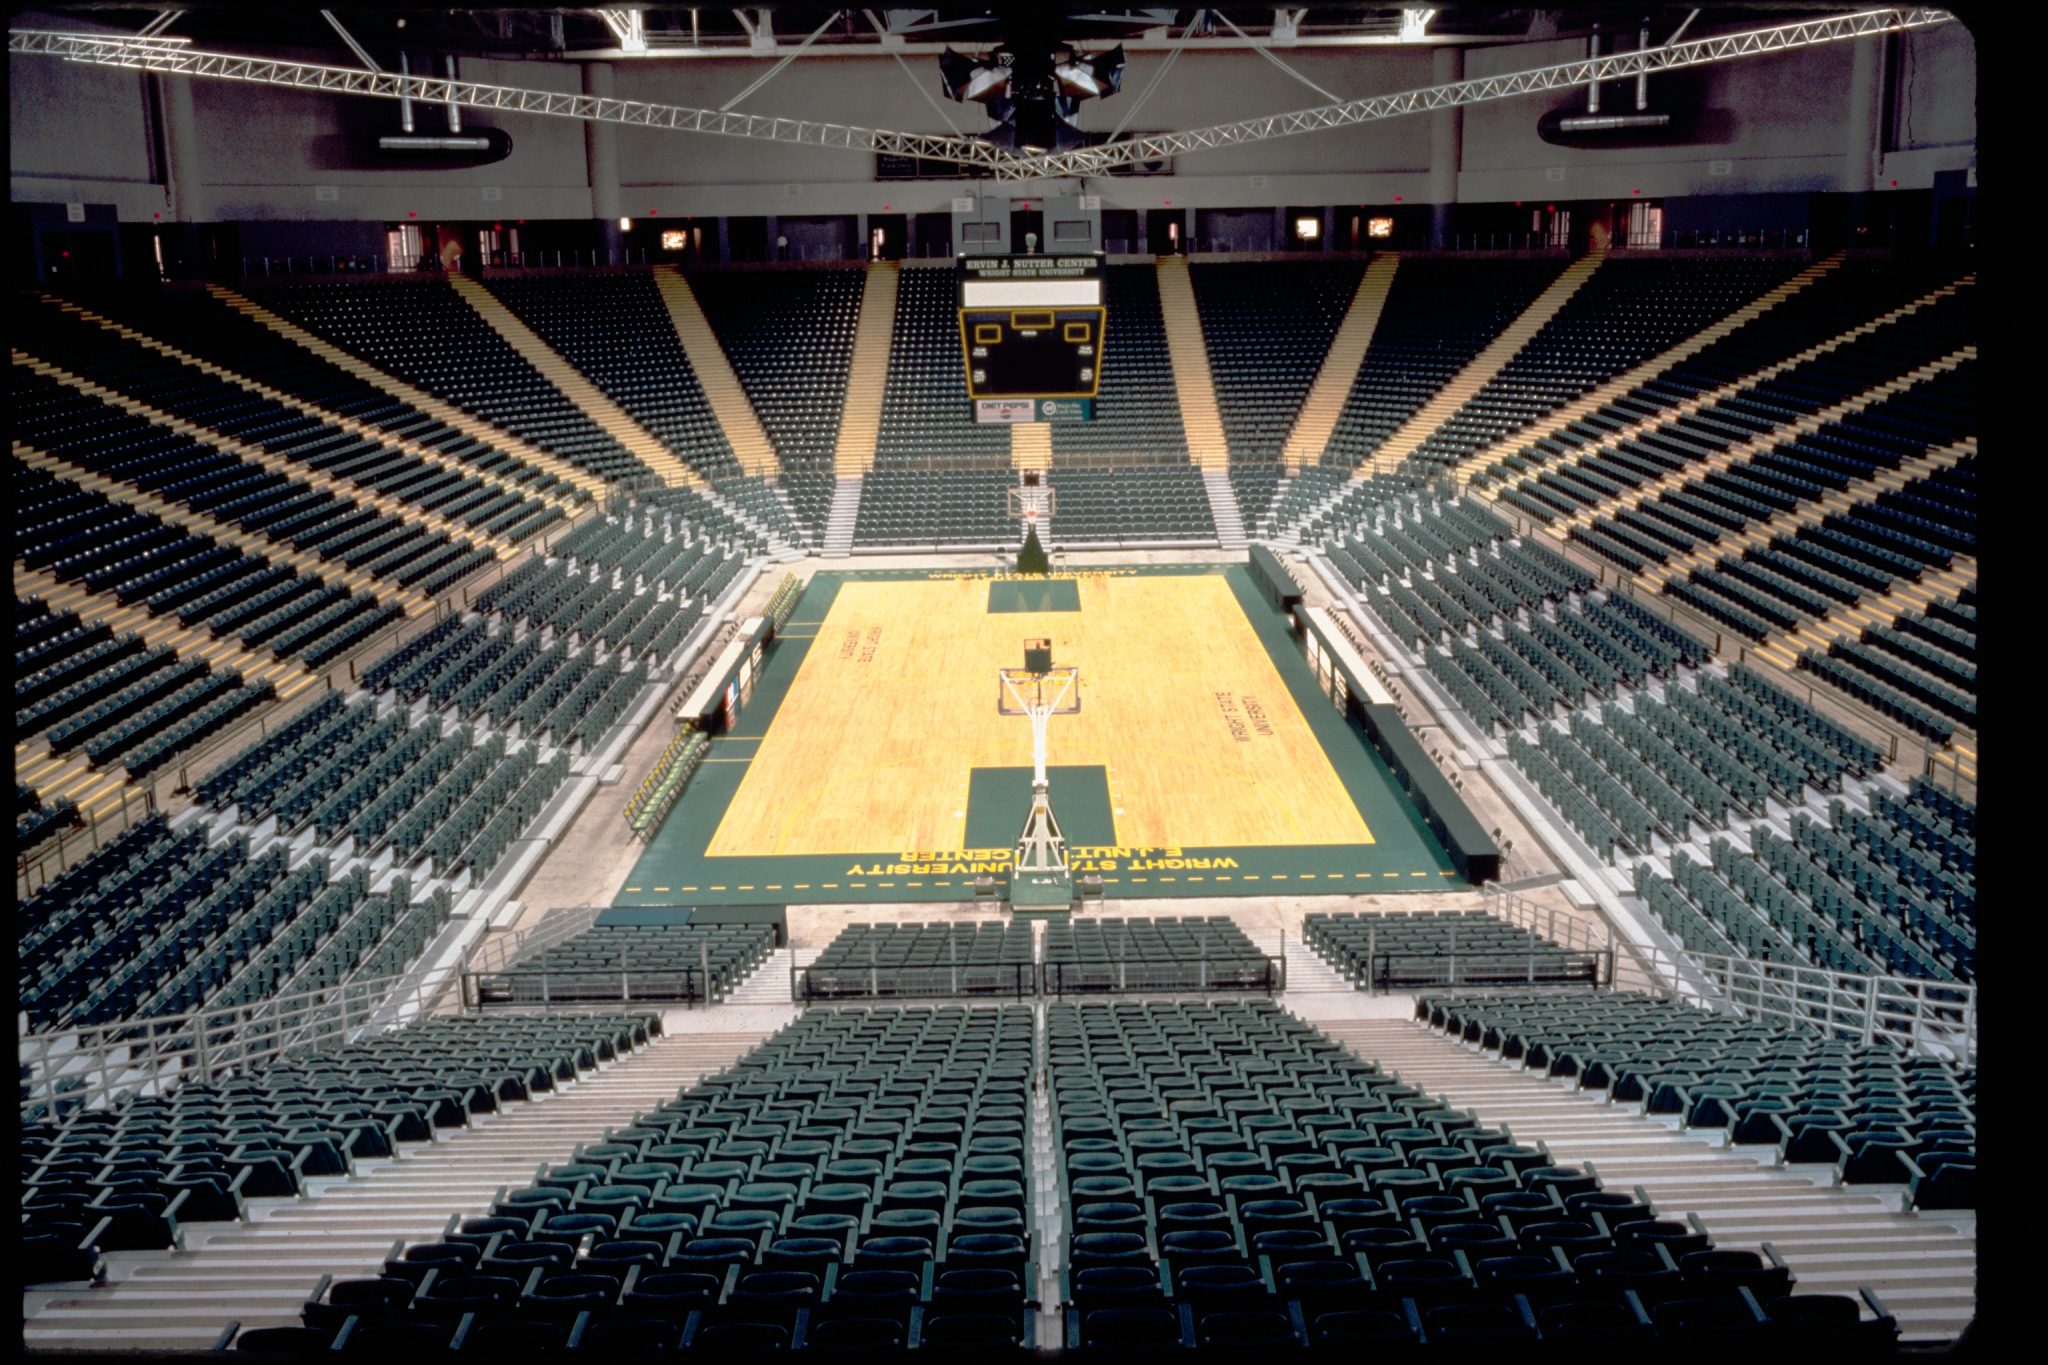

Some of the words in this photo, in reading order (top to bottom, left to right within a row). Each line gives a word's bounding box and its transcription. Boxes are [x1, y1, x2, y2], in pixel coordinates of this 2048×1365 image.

[966, 259, 999, 269] ERVIN
[1001, 259, 1010, 268] J.
[1013, 259, 1054, 268] NUTTER
[1057, 258, 1097, 268] CENTER
[979, 269, 1010, 277] WRIGHT
[1012, 269, 1037, 277] STATE
[1039, 268, 1085, 276] UNIVERSITY
[1215, 692, 1238, 712] STATE
[900, 849, 1012, 862] CENTER
[846, 861, 1013, 875] UNIVERSITY
[1128, 857, 1239, 870] WRIGHT
